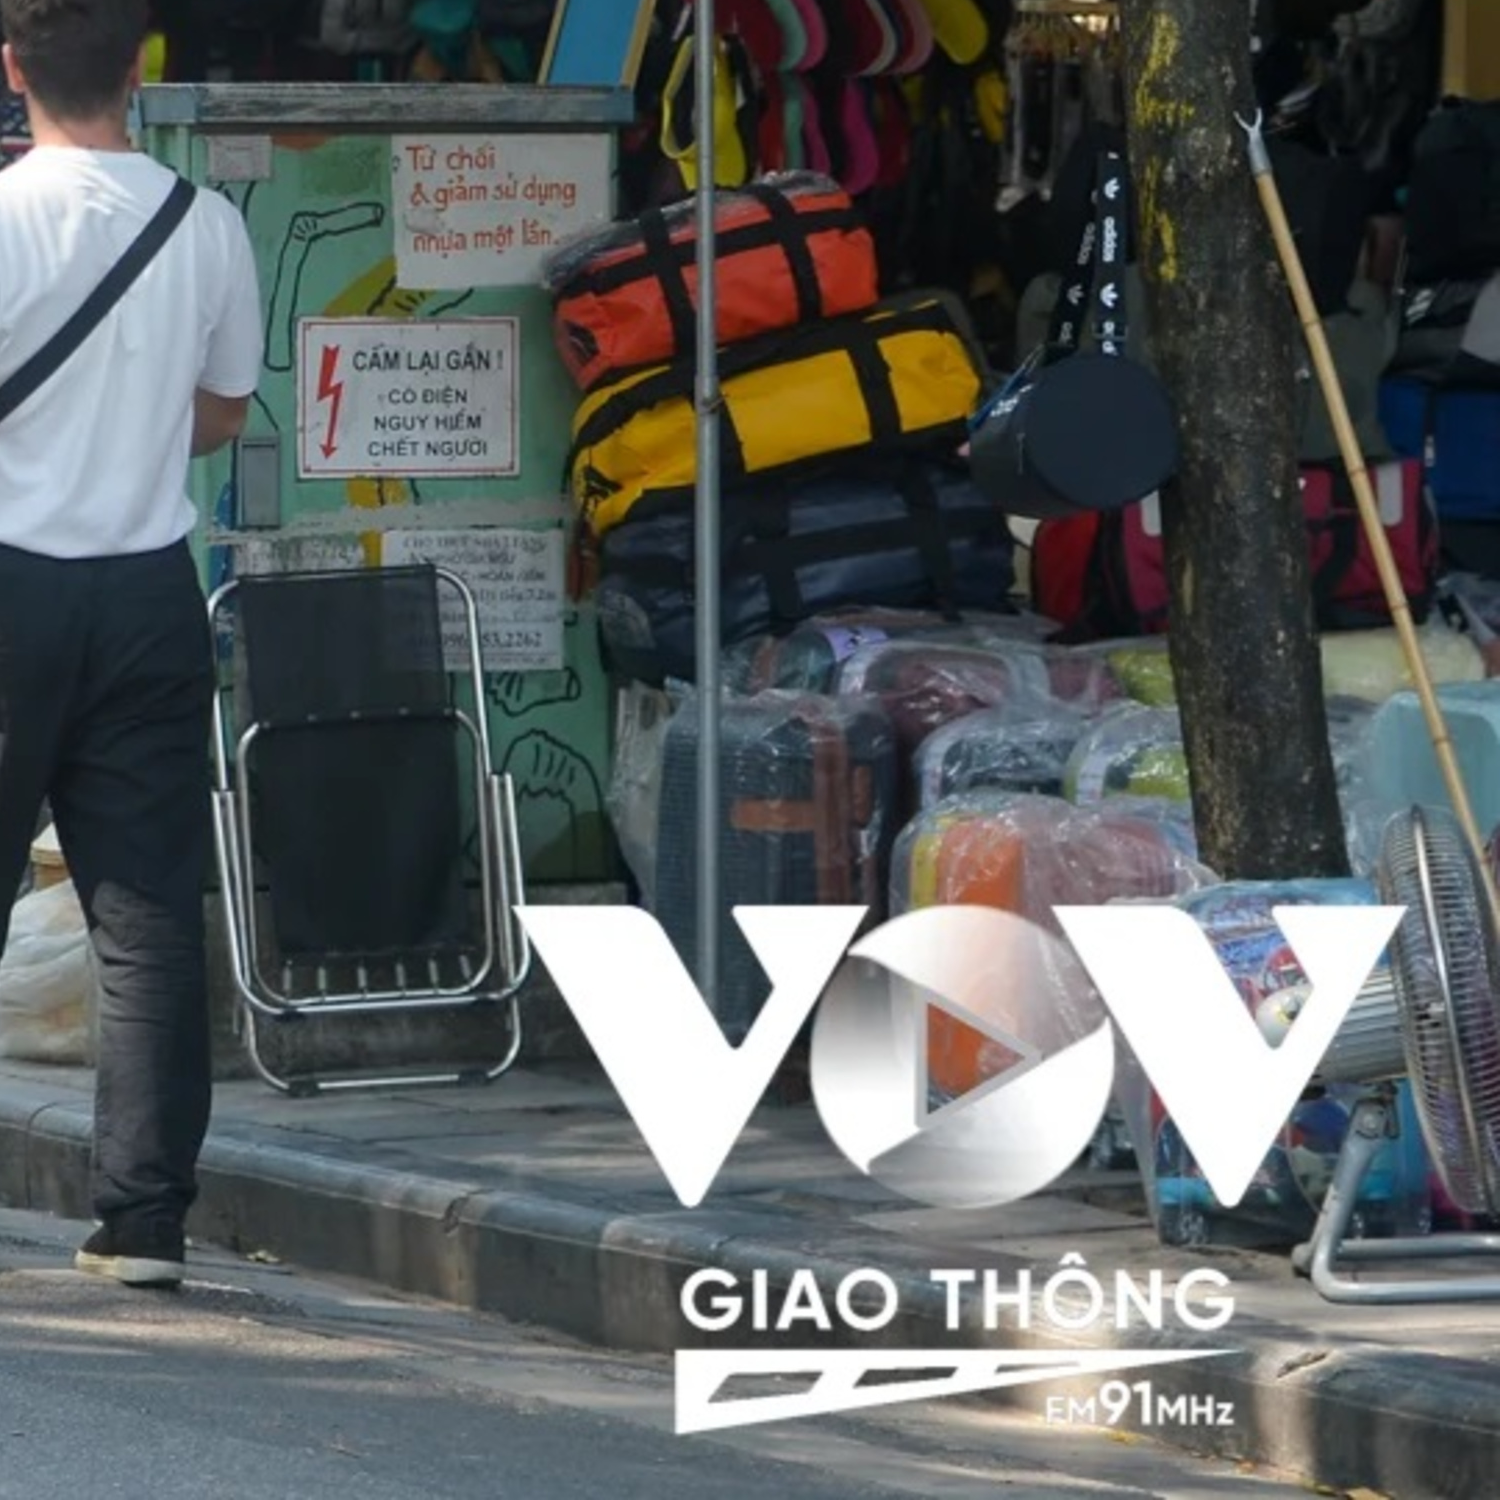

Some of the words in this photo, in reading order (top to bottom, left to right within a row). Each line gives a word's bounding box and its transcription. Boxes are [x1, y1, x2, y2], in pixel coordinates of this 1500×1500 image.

[410, 182, 430, 207] &
[522, 174, 576, 208] dụng
[353, 343, 400, 371] CẤM
[407, 350, 440, 376] LẠI
[374, 415, 429, 431] NGUY
